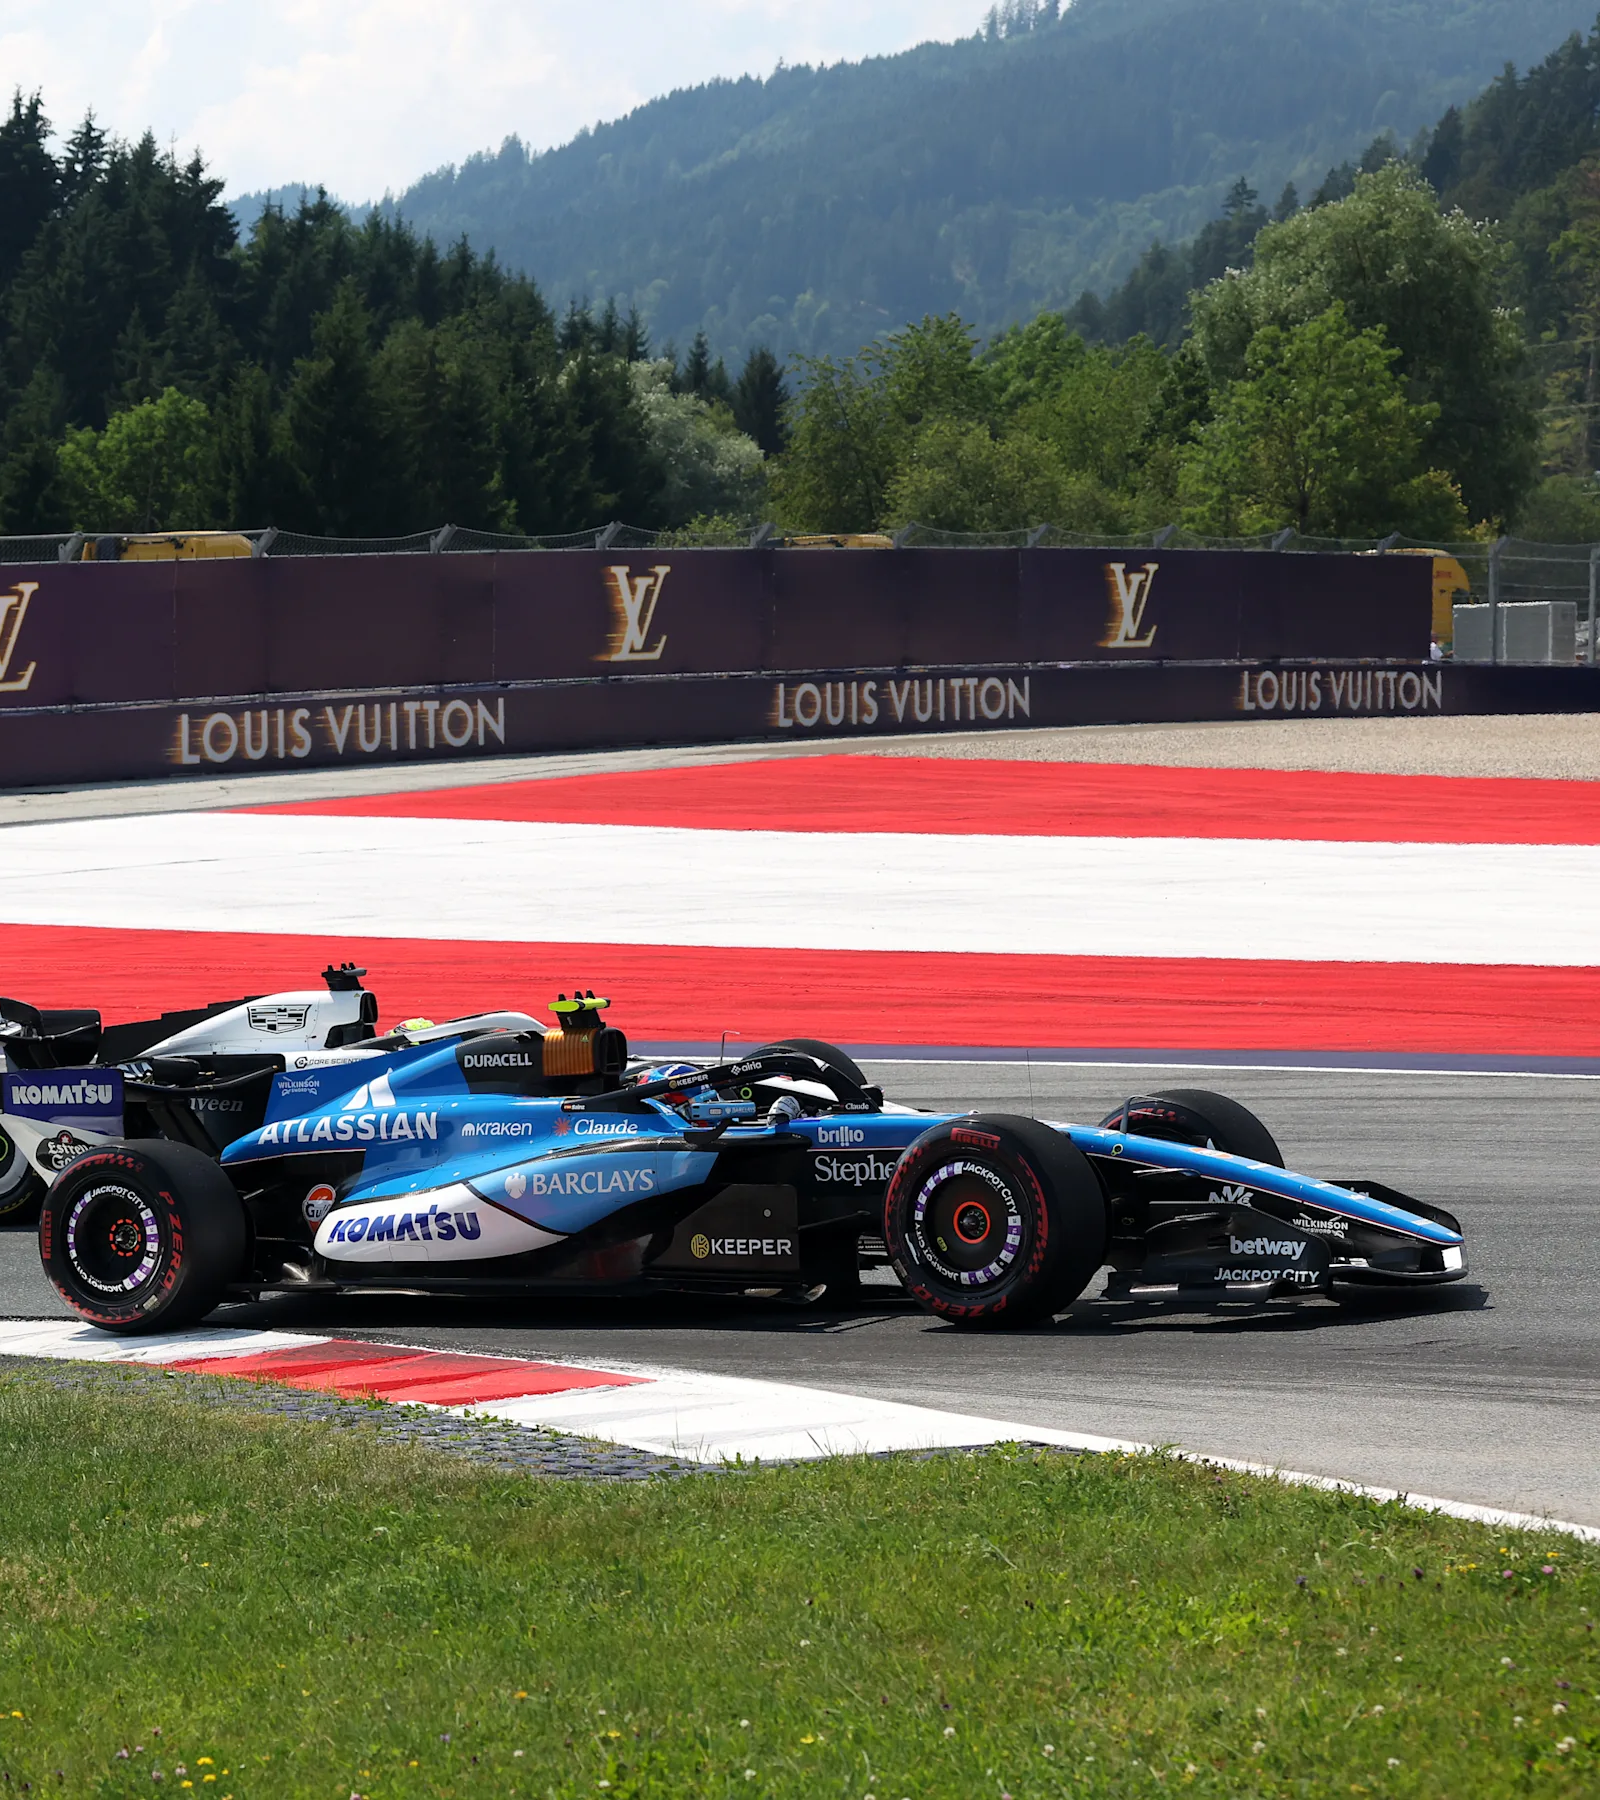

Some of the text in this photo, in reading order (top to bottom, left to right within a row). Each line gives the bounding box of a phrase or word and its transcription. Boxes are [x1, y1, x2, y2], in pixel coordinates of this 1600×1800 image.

[778, 676, 1030, 727] LOUIS VUITTON
[1243, 670, 1442, 711] LOUIS VUITTON
[181, 697, 505, 764] LOUIS VUITTON
[464, 1053, 533, 1068] DURACELL
[741, 1061, 762, 1072] airia
[11, 1079, 113, 1105] KOMATSU
[277, 1080, 320, 1089] WILKINSON
[676, 1074, 709, 1087] KEEPER
[845, 1102, 870, 1110] Claude
[257, 1112, 438, 1145] ATLASSIAN
[574, 1118, 638, 1135] Claude
[951, 1127, 1001, 1150] PIRELLI
[532, 1168, 654, 1195] BARCLAYS
[815, 1154, 896, 1186] Stephe
[91, 1185, 128, 1199] JACKPOT
[126, 1191, 148, 1211] CITY
[962, 1161, 1018, 1215] JACKPOT CITY
[305, 1202, 331, 1218] Gulf
[327, 1204, 481, 1244] KOMATSU
[914, 1221, 926, 1247] CITY
[1292, 1218, 1349, 1230] WILKINSON
[159, 1190, 185, 1290] P ZERO
[711, 1238, 792, 1255] KEEPER
[1230, 1236, 1307, 1260] betway
[72, 1259, 92, 1281] CITY
[922, 1245, 960, 1282] JACKPOT
[1214, 1268, 1319, 1283] JACKPOT CITY
[87, 1277, 124, 1294] JACKPOT
[912, 1284, 1008, 1318] P ZERO
